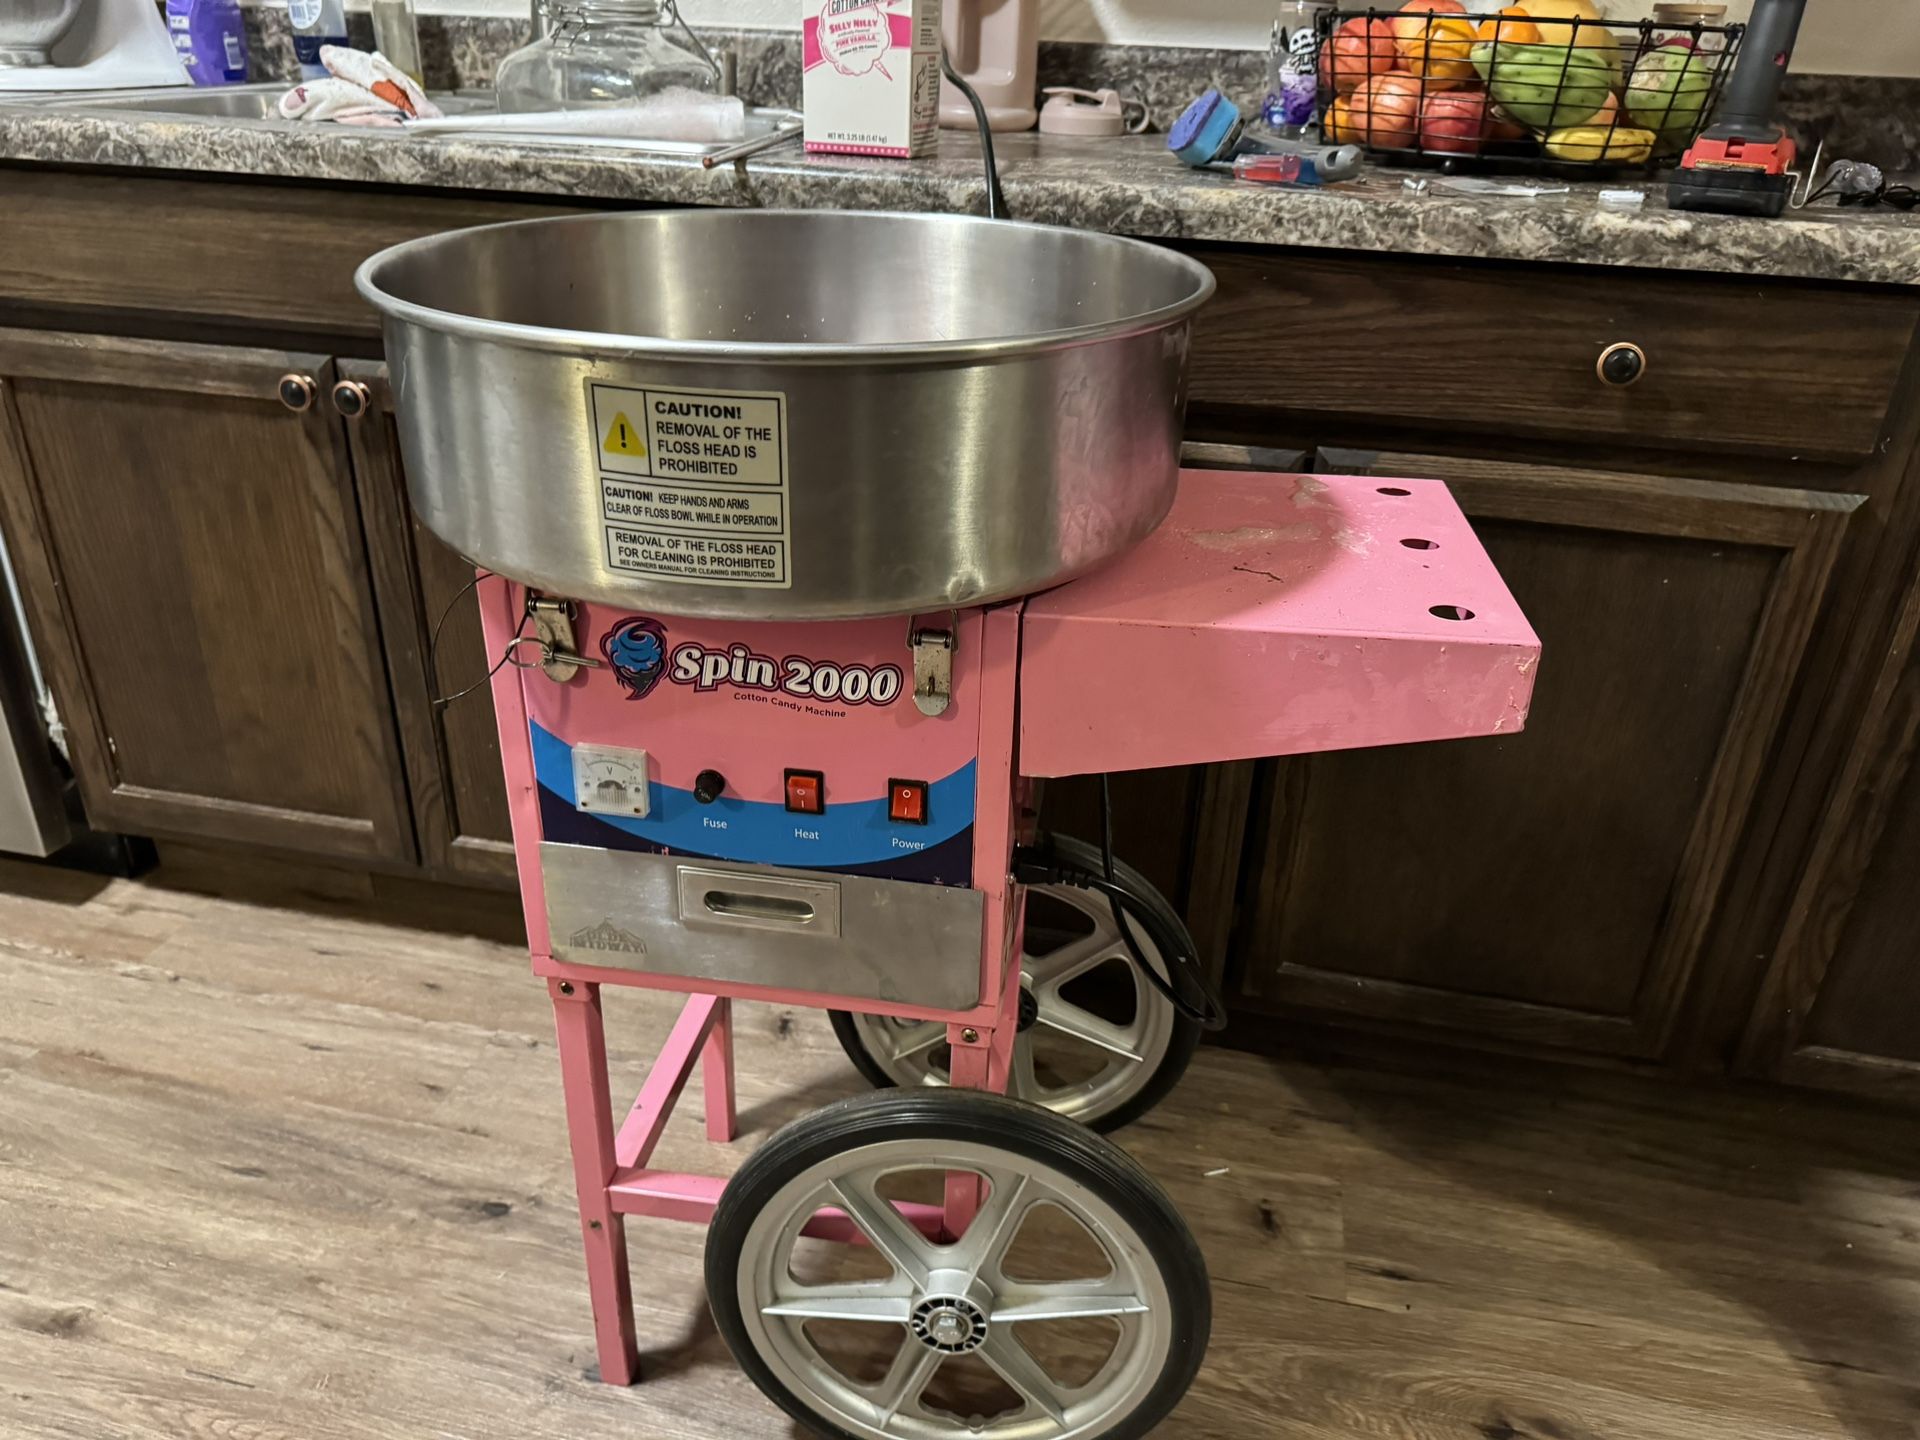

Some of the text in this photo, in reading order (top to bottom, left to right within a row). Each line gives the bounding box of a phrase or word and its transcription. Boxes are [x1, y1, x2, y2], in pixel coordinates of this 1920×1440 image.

[829, 21, 851, 33] SILLY
[853, 19, 878, 27] NILLY
[655, 401, 741, 419] CAUTION!
[657, 421, 771, 440] REMOVAL OF THE
[658, 440, 756, 458] FLOSS HEAD IS
[659, 458, 737, 475] PROHIBITED
[606, 486, 749, 509] CAUTION! KEEP HANDS AND ARMS
[607, 503, 777, 526] CLEAR OF FLOSS BOWL WHILE IN OPERATION
[616, 532, 776, 555] REMOVAL OF THE FLOSS HEAD
[619, 547, 775, 569] FOR CLEANING IS PROHIBITED
[632, 561, 657, 569] OWNERS
[659, 564, 683, 572] MANUAL
[698, 568, 729, 576] CLEANING
[731, 570, 775, 578] INSTRUCTIONS
[673, 646, 900, 702] Spin 2000
[734, 692, 846, 718] Cotton Candy Machine
[606, 766, 612, 775] V
[703, 817, 727, 829] Fuse
[795, 828, 819, 840] Heat
[892, 838, 925, 850] Power
